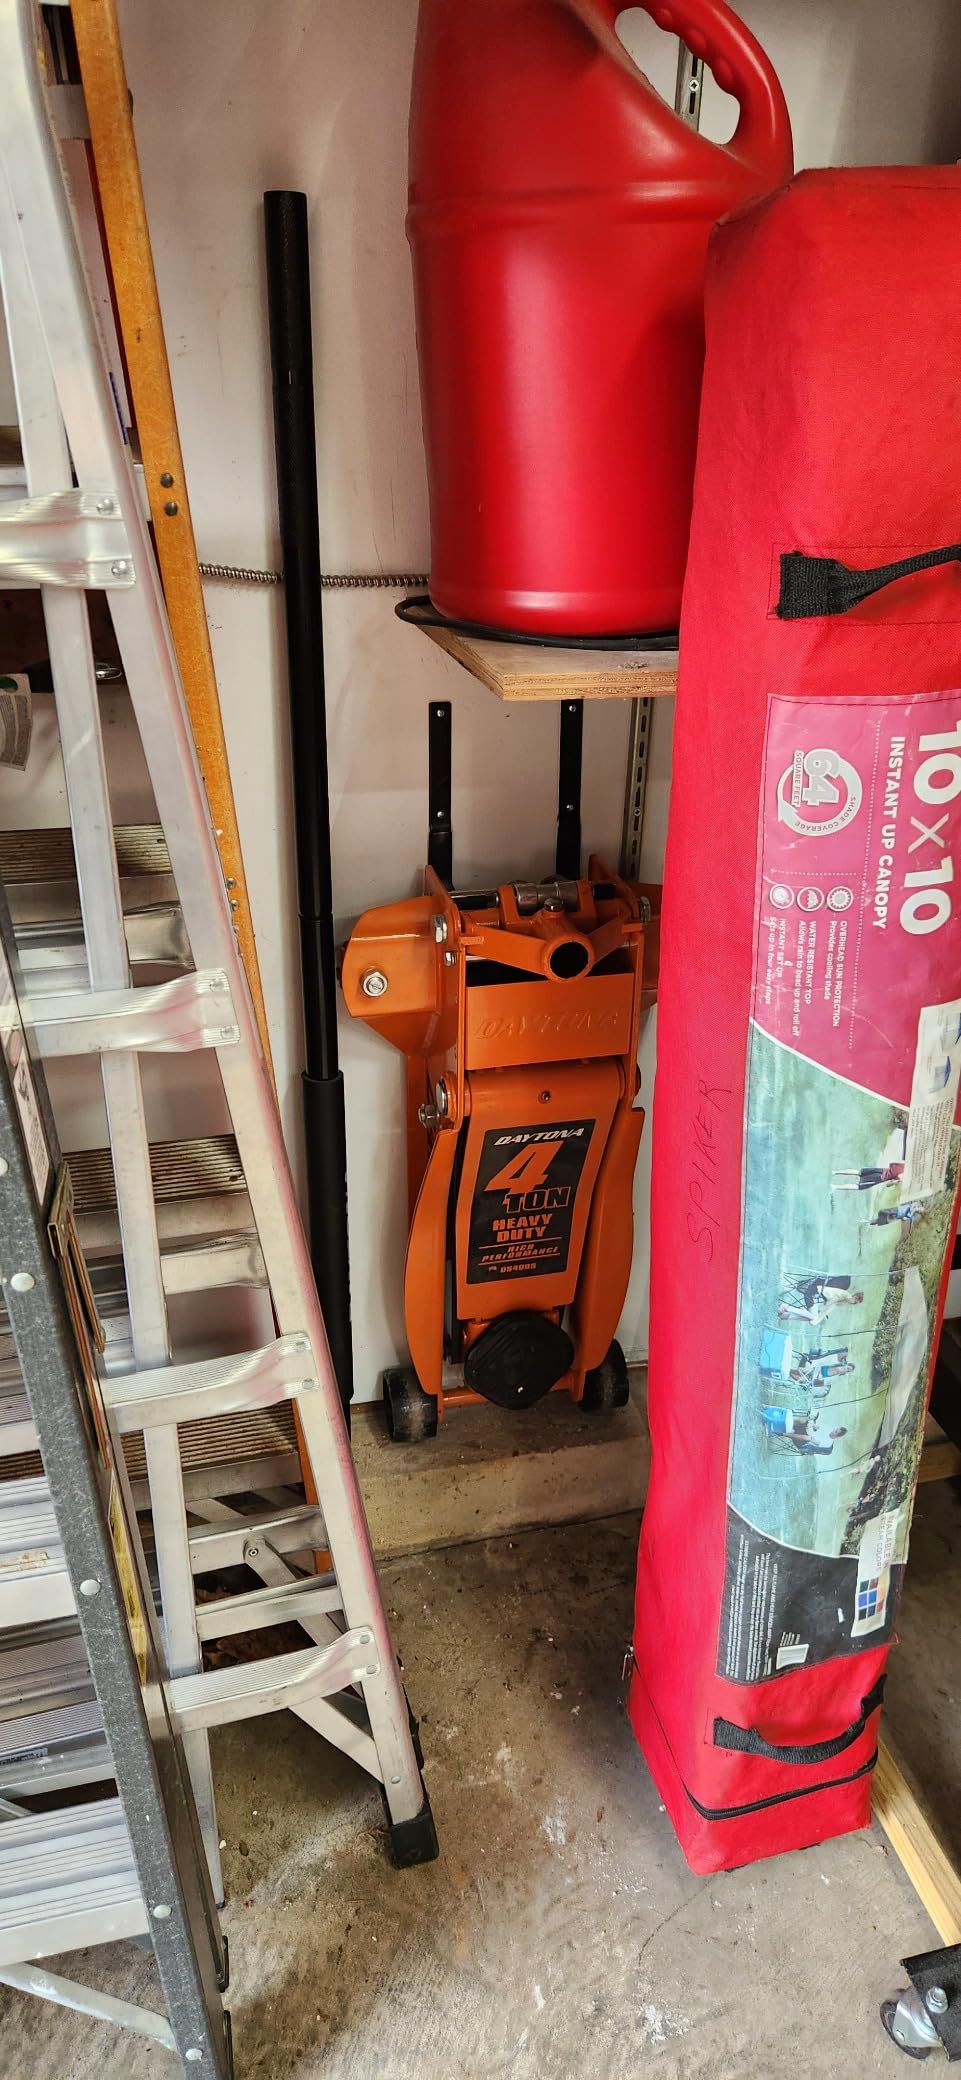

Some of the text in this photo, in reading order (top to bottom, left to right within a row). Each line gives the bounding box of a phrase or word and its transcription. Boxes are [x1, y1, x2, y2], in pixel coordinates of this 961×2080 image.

[913, 721, 961, 804] 10
[792, 752, 803, 807] SQUARE FEET
[802, 749, 840, 806] 64
[840, 796, 857, 823] SHADE
[872, 735, 906, 929] INSTANT UP CANOPY
[899, 855, 954, 935] 10
[778, 918, 787, 951] INSTANT
[798, 920, 807, 944] Allows
[808, 920, 817, 948] WATER
[776, 951, 784, 967] SET
[796, 960, 803, 969] to
[805, 949, 815, 988] RESISTANT
[824, 920, 837, 1000] Provides cooling shade
[832, 920, 848, 1027] OVERHEAD SUN PROTECTION
[793, 988, 801, 998] up
[793, 998, 801, 1013] and
[792, 1013, 800, 1025] roll
[792, 1025, 800, 1037] off
[493, 1127, 584, 1146] DAYTONA
[484, 1140, 564, 1205] 4
[686, 1079, 732, 1263] SPIKER
[505, 1186, 571, 1213] TON
[492, 1213, 552, 1232] HEAVY
[496, 1226, 547, 1243] DUTY
[481, 1246, 559, 1262] PERFORMANCE
[507, 1243, 535, 1253] HIGH
